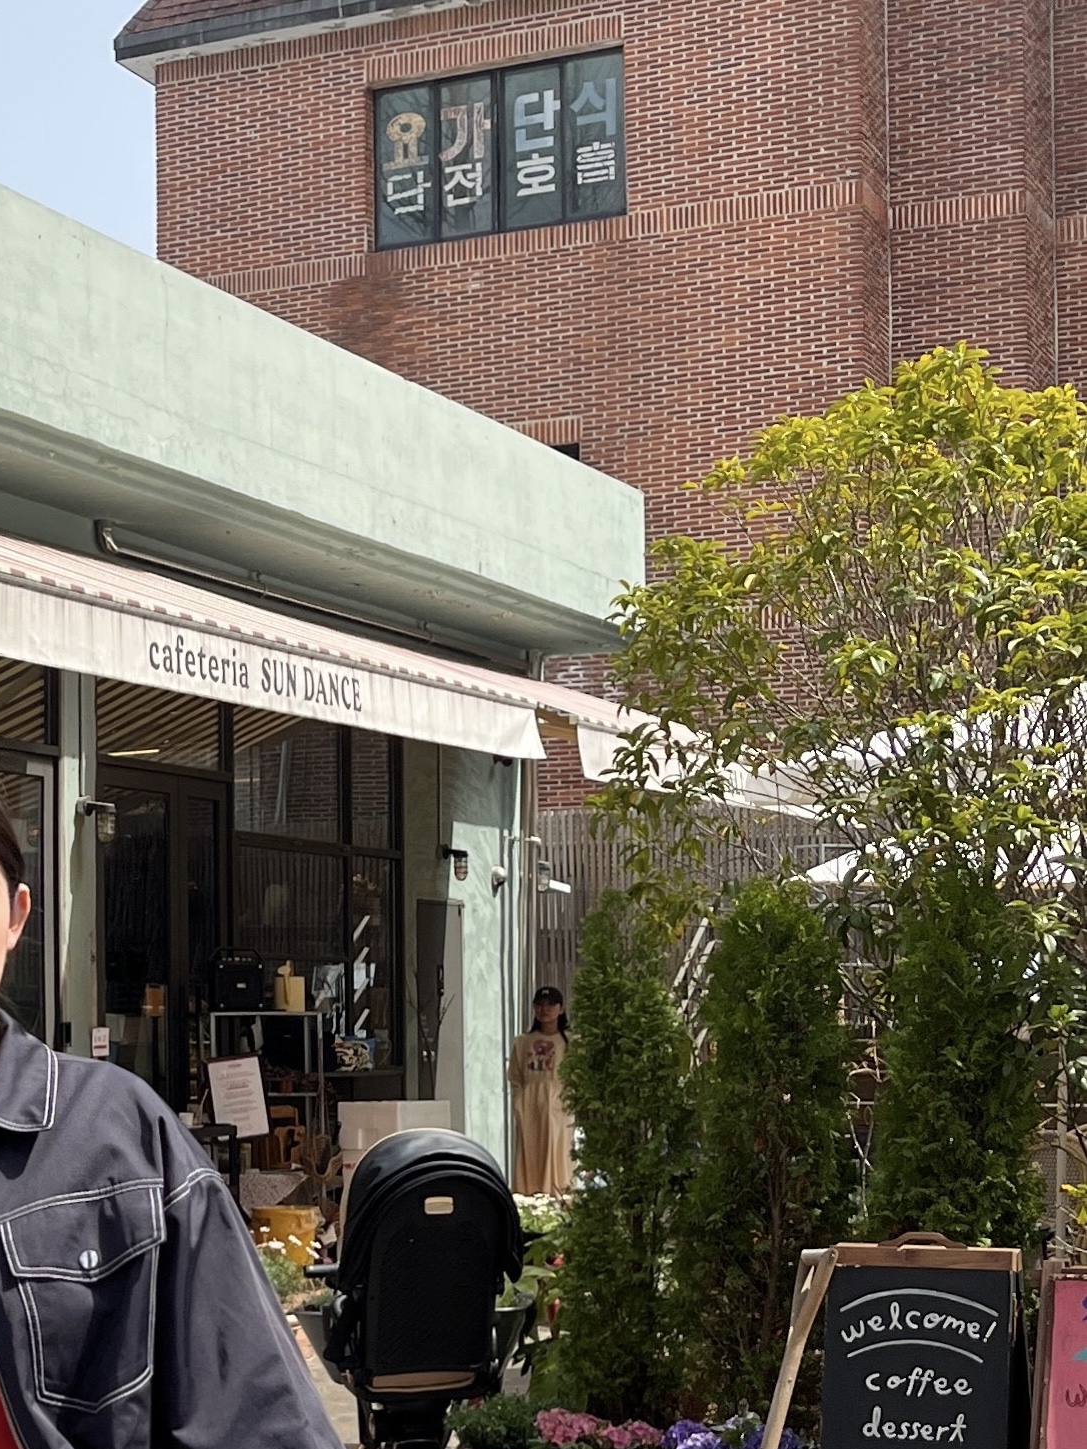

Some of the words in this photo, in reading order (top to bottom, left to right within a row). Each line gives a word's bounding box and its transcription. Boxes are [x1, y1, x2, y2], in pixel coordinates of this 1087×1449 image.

[382, 102, 492, 172] 요가
[514, 78, 617, 153] 단식
[386, 163, 483, 216] 단전
[516, 141, 616, 198] 호흡
[148, 634, 250, 690] cafeteria
[840, 1301, 998, 1343] welcome!
[865, 1366, 973, 1398] coffee
[862, 1405, 967, 1443] dessert
